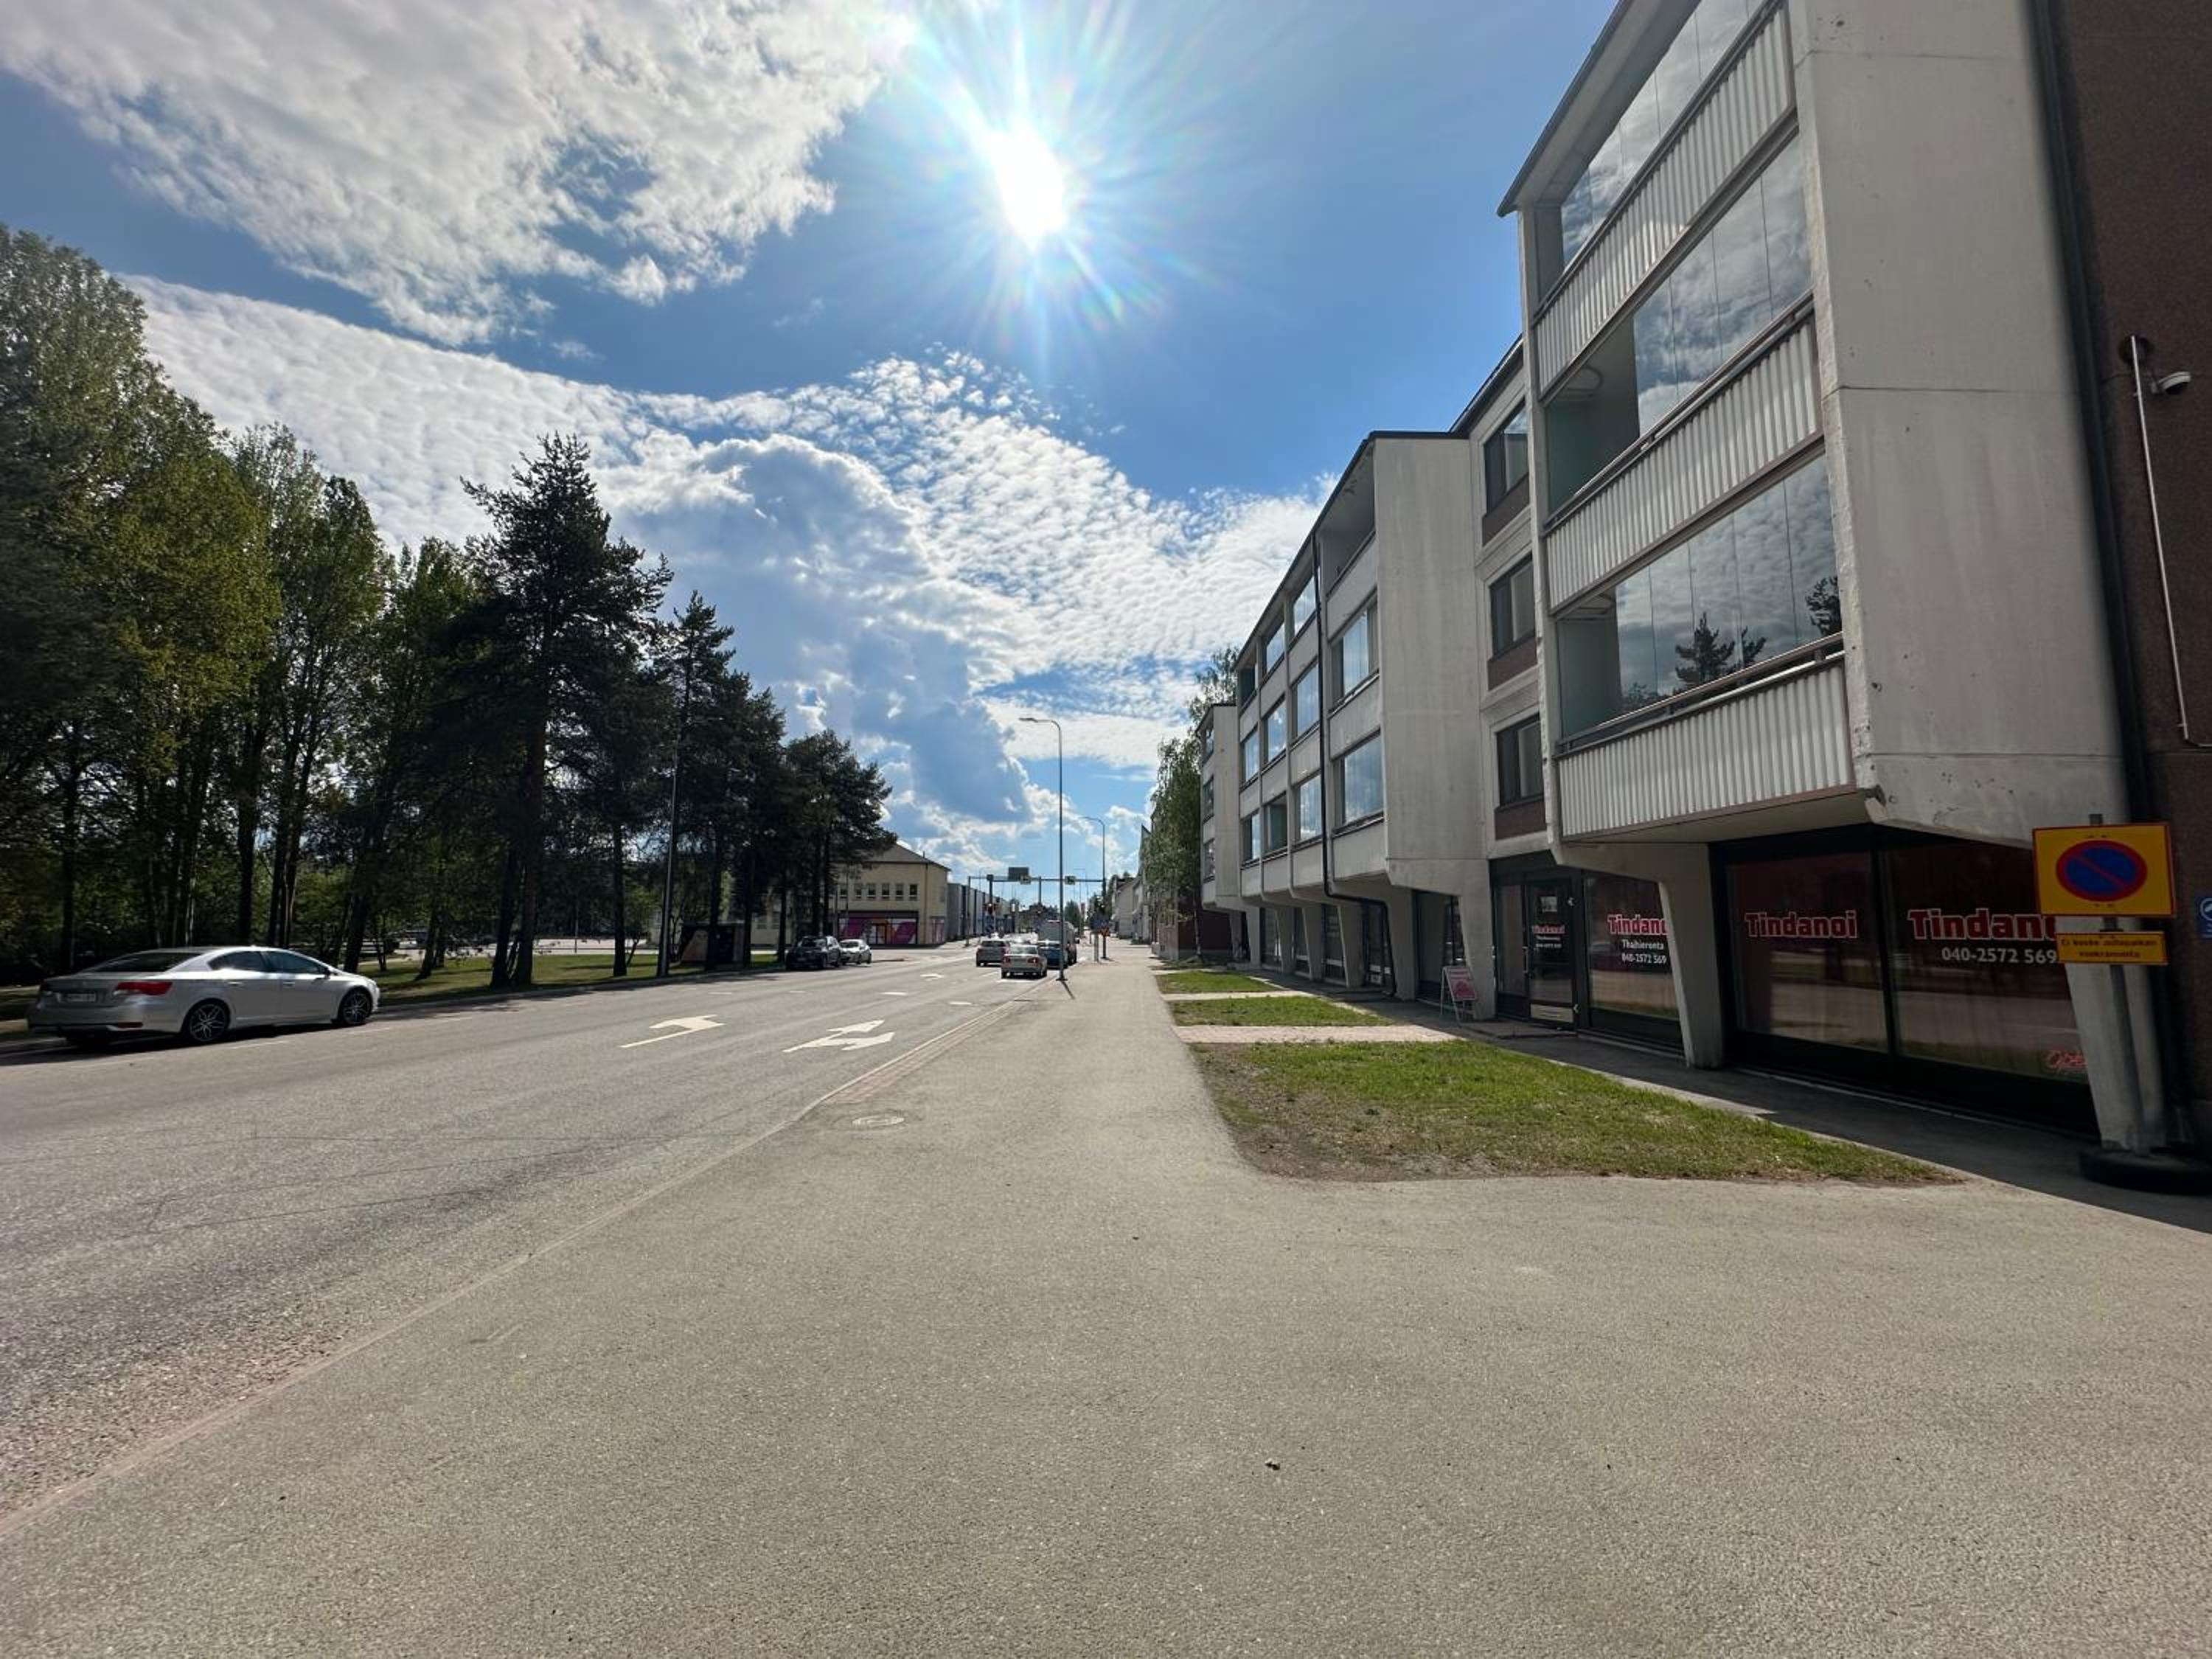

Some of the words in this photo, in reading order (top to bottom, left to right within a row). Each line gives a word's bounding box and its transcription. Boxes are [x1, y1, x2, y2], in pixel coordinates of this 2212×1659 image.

[1745, 910, 1858, 939] Tindanoi
[1941, 947, 2018, 962] 040-2572
[2024, 949, 2057, 964] 569
